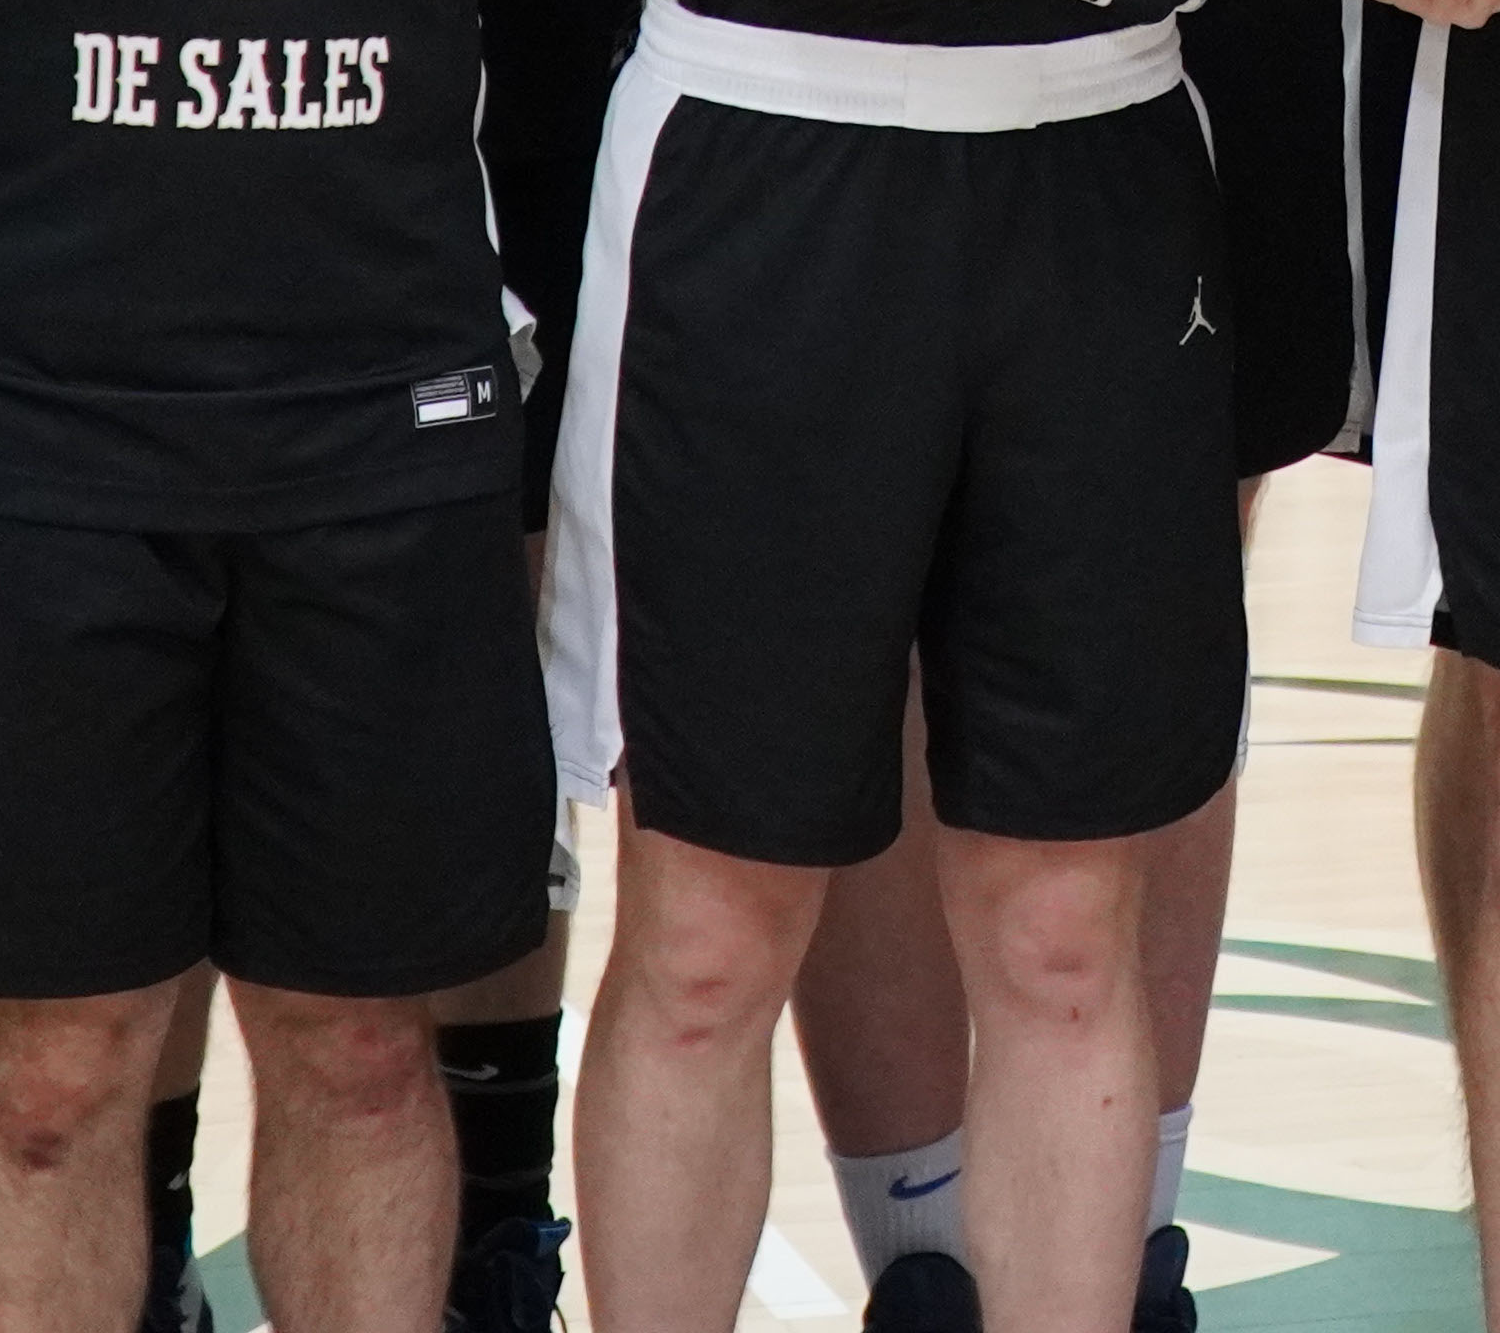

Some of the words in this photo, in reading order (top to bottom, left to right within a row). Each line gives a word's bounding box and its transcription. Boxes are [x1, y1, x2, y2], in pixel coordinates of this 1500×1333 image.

[72, 32, 159, 127] DE
[176, 36, 389, 130] SALES
[476, 380, 492, 405] M
